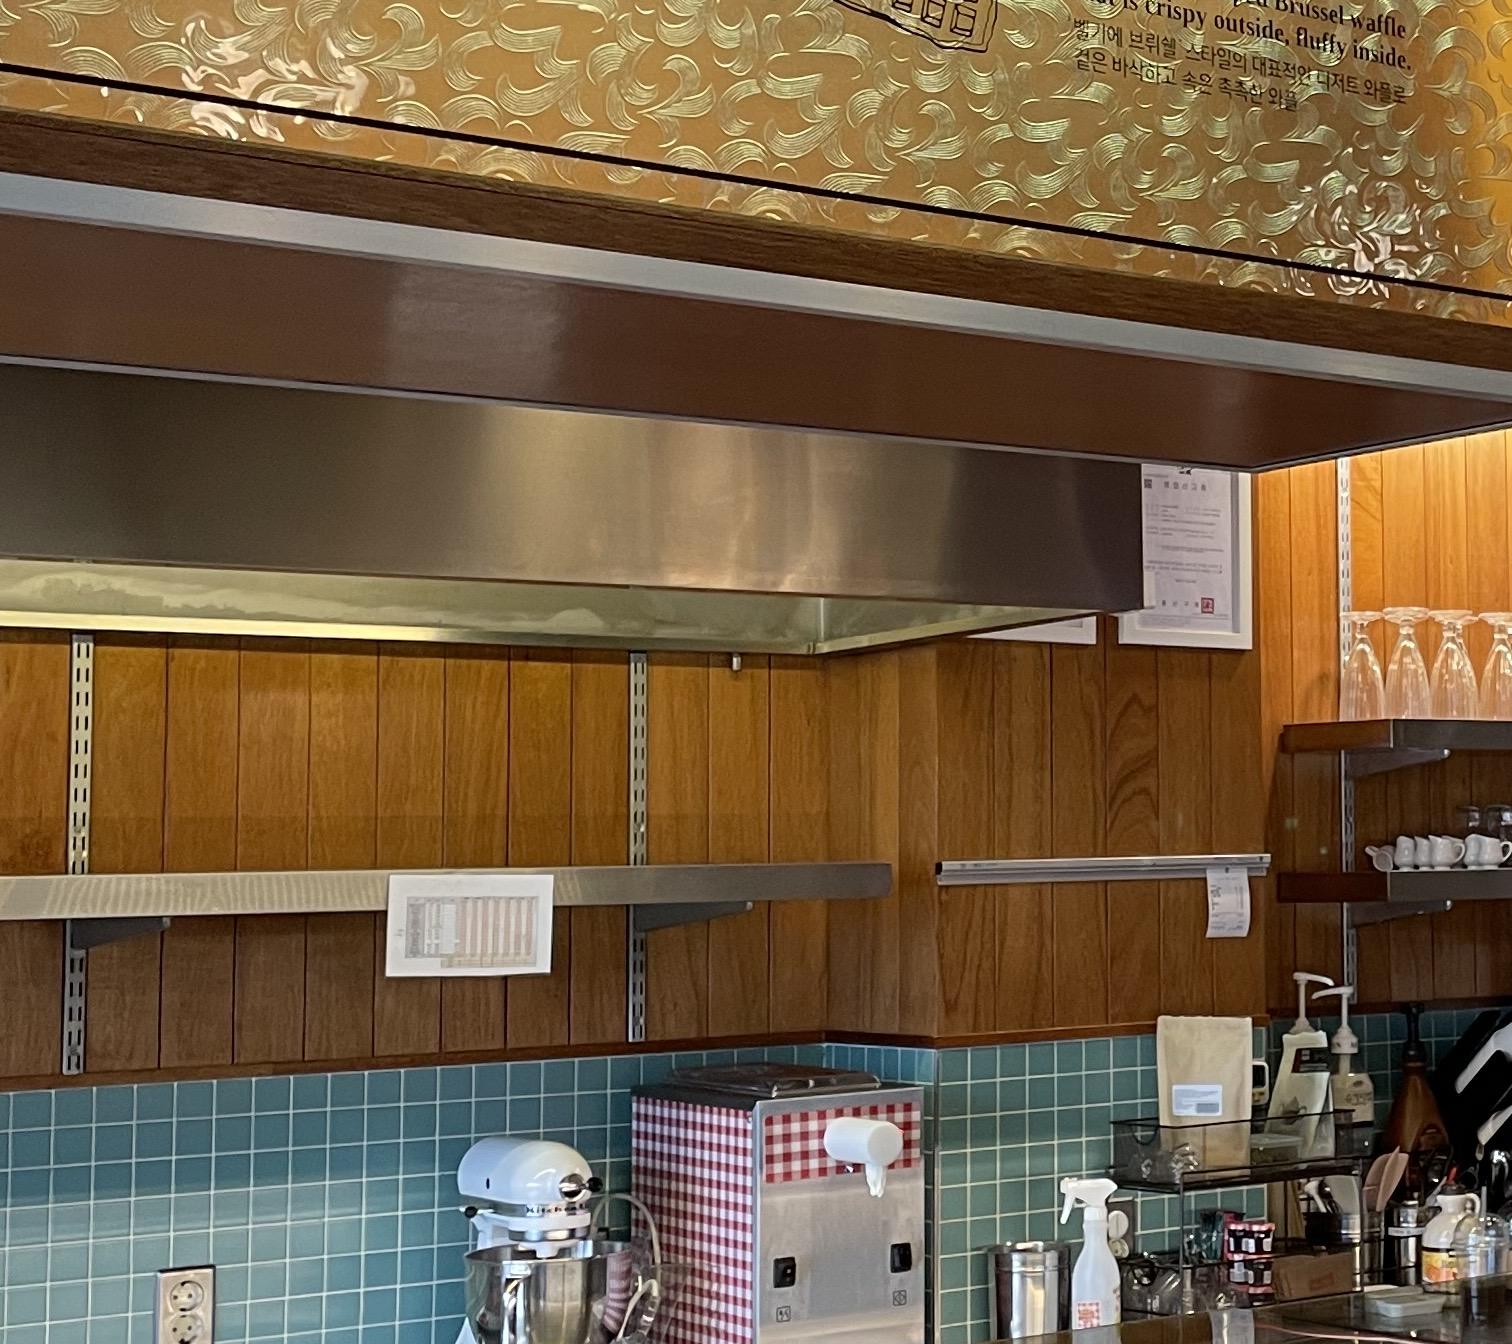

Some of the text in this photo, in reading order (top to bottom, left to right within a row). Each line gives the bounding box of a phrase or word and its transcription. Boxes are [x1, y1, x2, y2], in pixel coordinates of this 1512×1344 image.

[1214, 13, 1290, 47] outside,
[1296, 26, 1348, 57] fluffy
[1353, 39, 1412, 71] inside.
[1350, 13, 1407, 39] waffle
[1074, 47, 1298, 112] 겉은 바삭하고 속은 촉촉한 와플
[1185, 42, 1248, 74] 스타일의
[1316, 70, 1361, 96] 디저트
